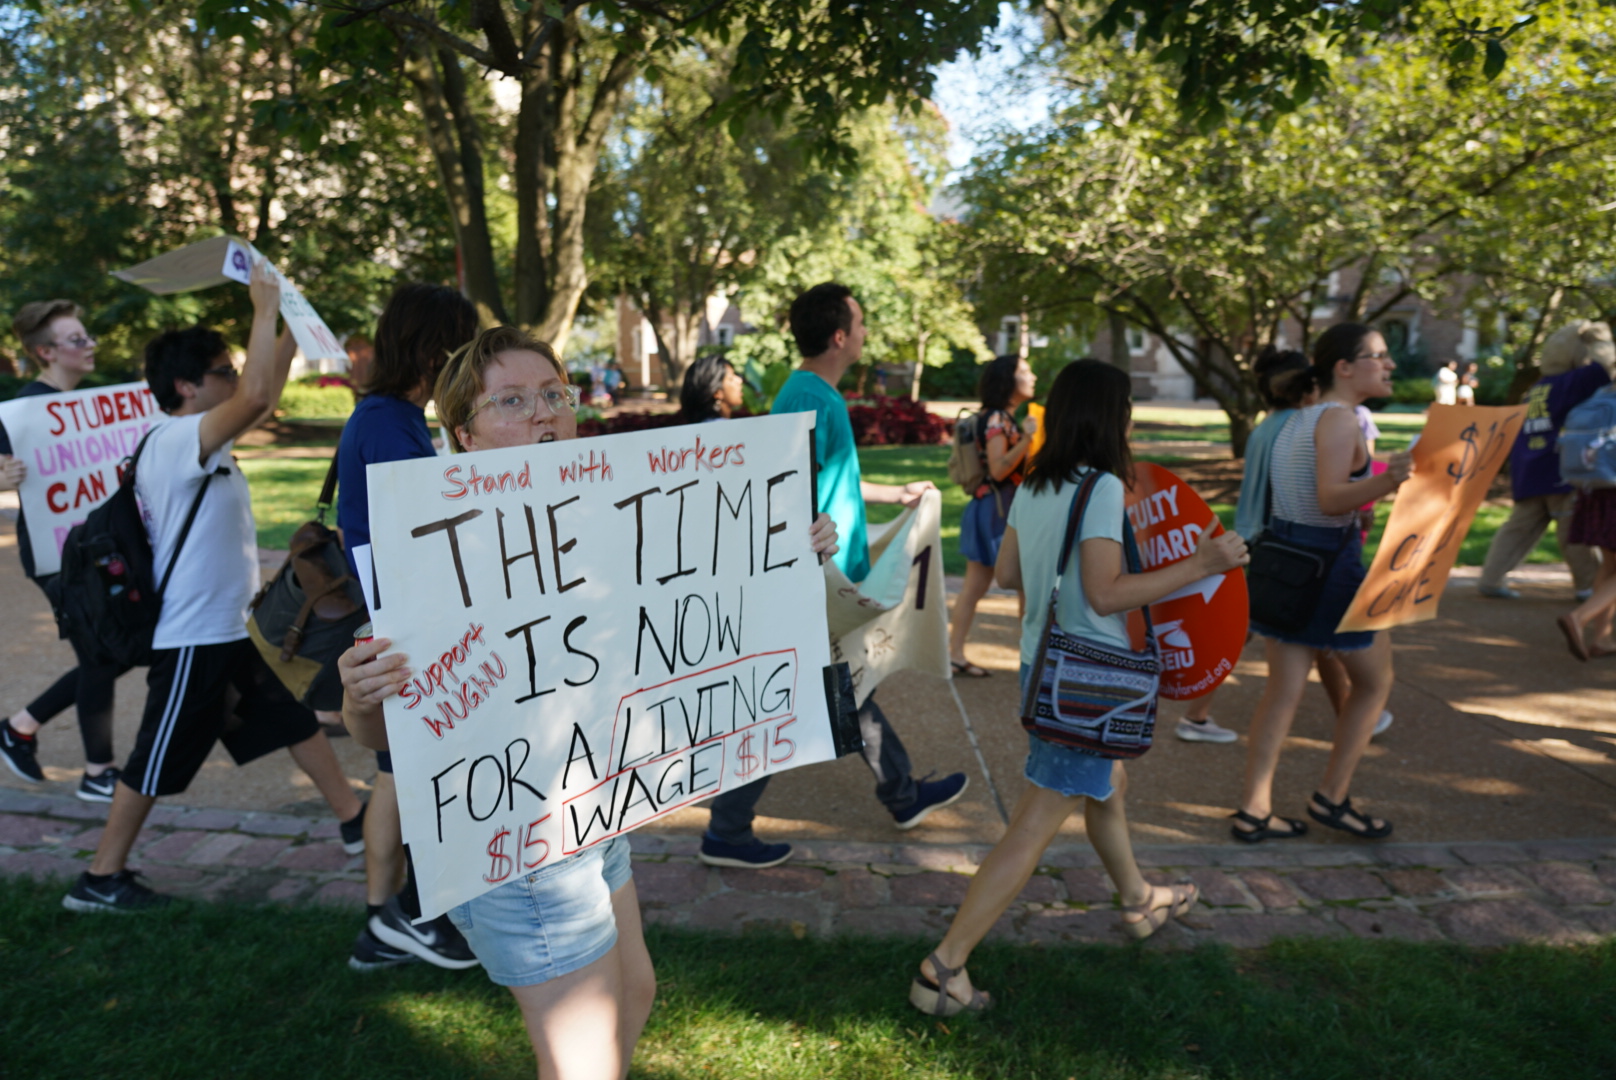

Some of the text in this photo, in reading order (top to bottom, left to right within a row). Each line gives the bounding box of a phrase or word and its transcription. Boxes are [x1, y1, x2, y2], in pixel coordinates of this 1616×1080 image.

[46, 388, 165, 436] STUDENT
[46, 470, 107, 513] CAN
[441, 460, 532, 500] Stand
[559, 449, 613, 484] with
[411, 470, 799, 608] THE TIME
[420, 650, 508, 741] WUGWU
[505, 586, 743, 703] IS NOW
[430, 664, 791, 843] FOR A LIVING
[482, 716, 798, 885] $15 WAGE $15
